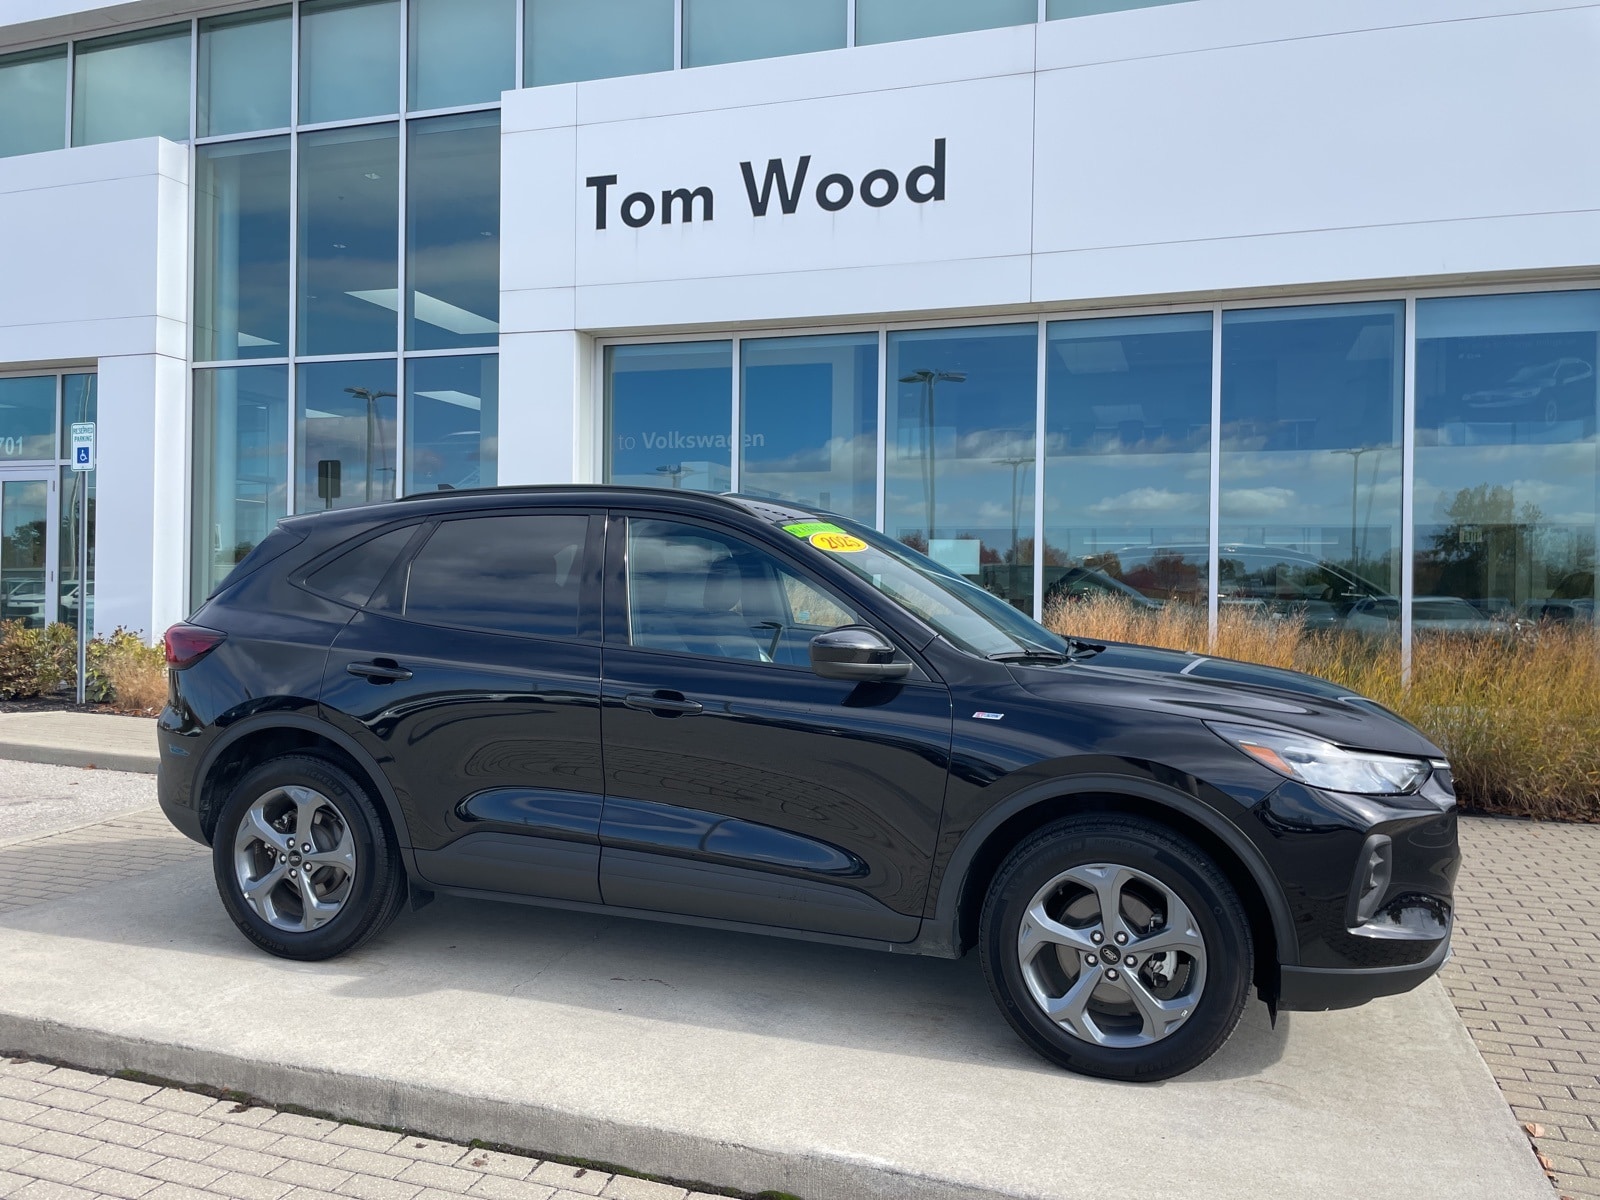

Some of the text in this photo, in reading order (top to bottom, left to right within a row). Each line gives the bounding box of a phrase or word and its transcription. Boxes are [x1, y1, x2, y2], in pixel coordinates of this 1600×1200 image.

[586, 137, 946, 230] Tom Wood
[618, 434, 636, 450] to
[820, 535, 862, 549] 2025
